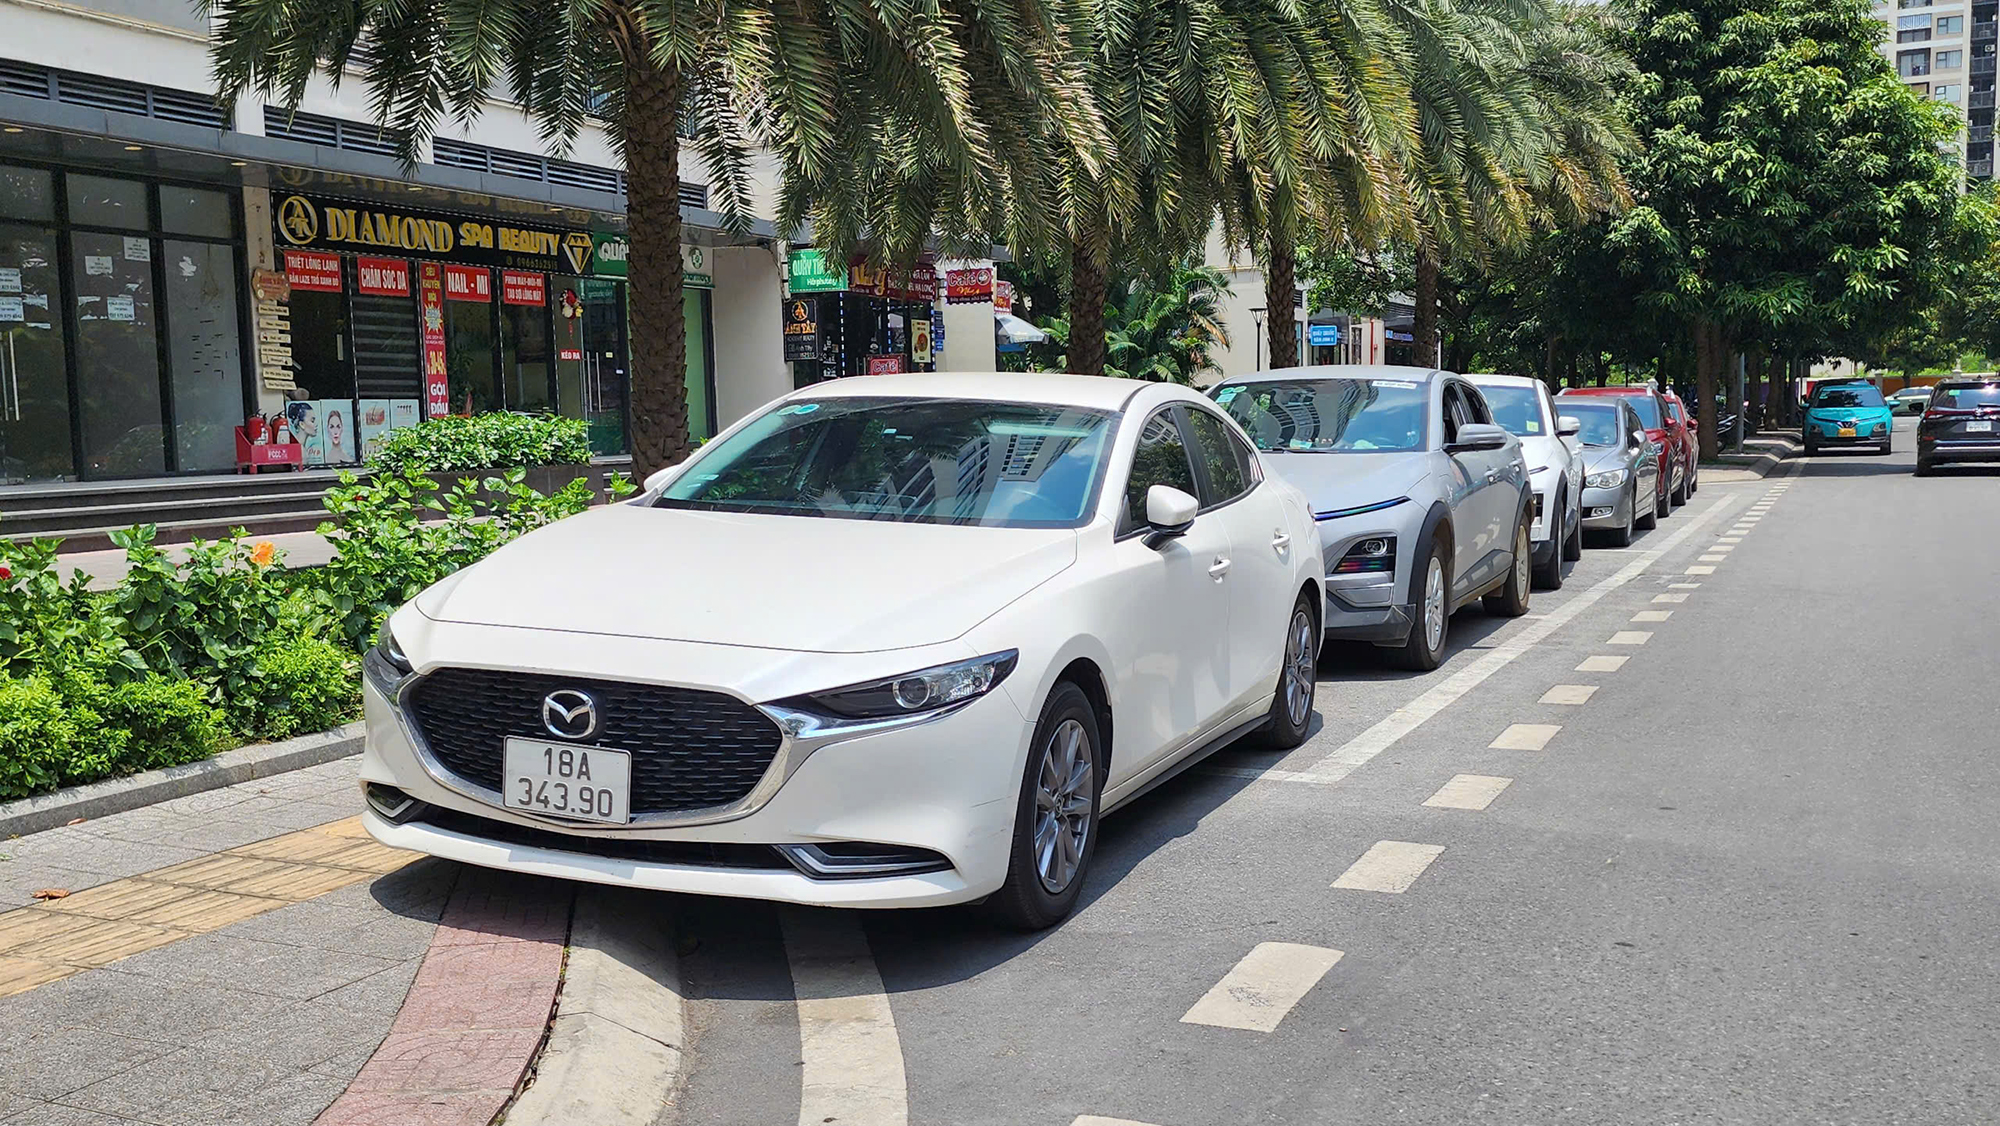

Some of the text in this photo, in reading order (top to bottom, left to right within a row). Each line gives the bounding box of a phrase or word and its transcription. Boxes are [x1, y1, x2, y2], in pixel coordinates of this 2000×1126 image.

[324, 207, 454, 252] DIAMOND
[459, 222, 494, 249] SPA
[498, 227, 560, 256] BEAUTY
[598, 236, 629, 261] QUẦ
[361, 265, 407, 290] CHĂM SÓC DA
[447, 272, 469, 294] NAIL
[948, 271, 977, 287] Café
[873, 361, 898, 373] Café
[543, 747, 592, 782] 18A
[518, 777, 613, 818] 343.90
